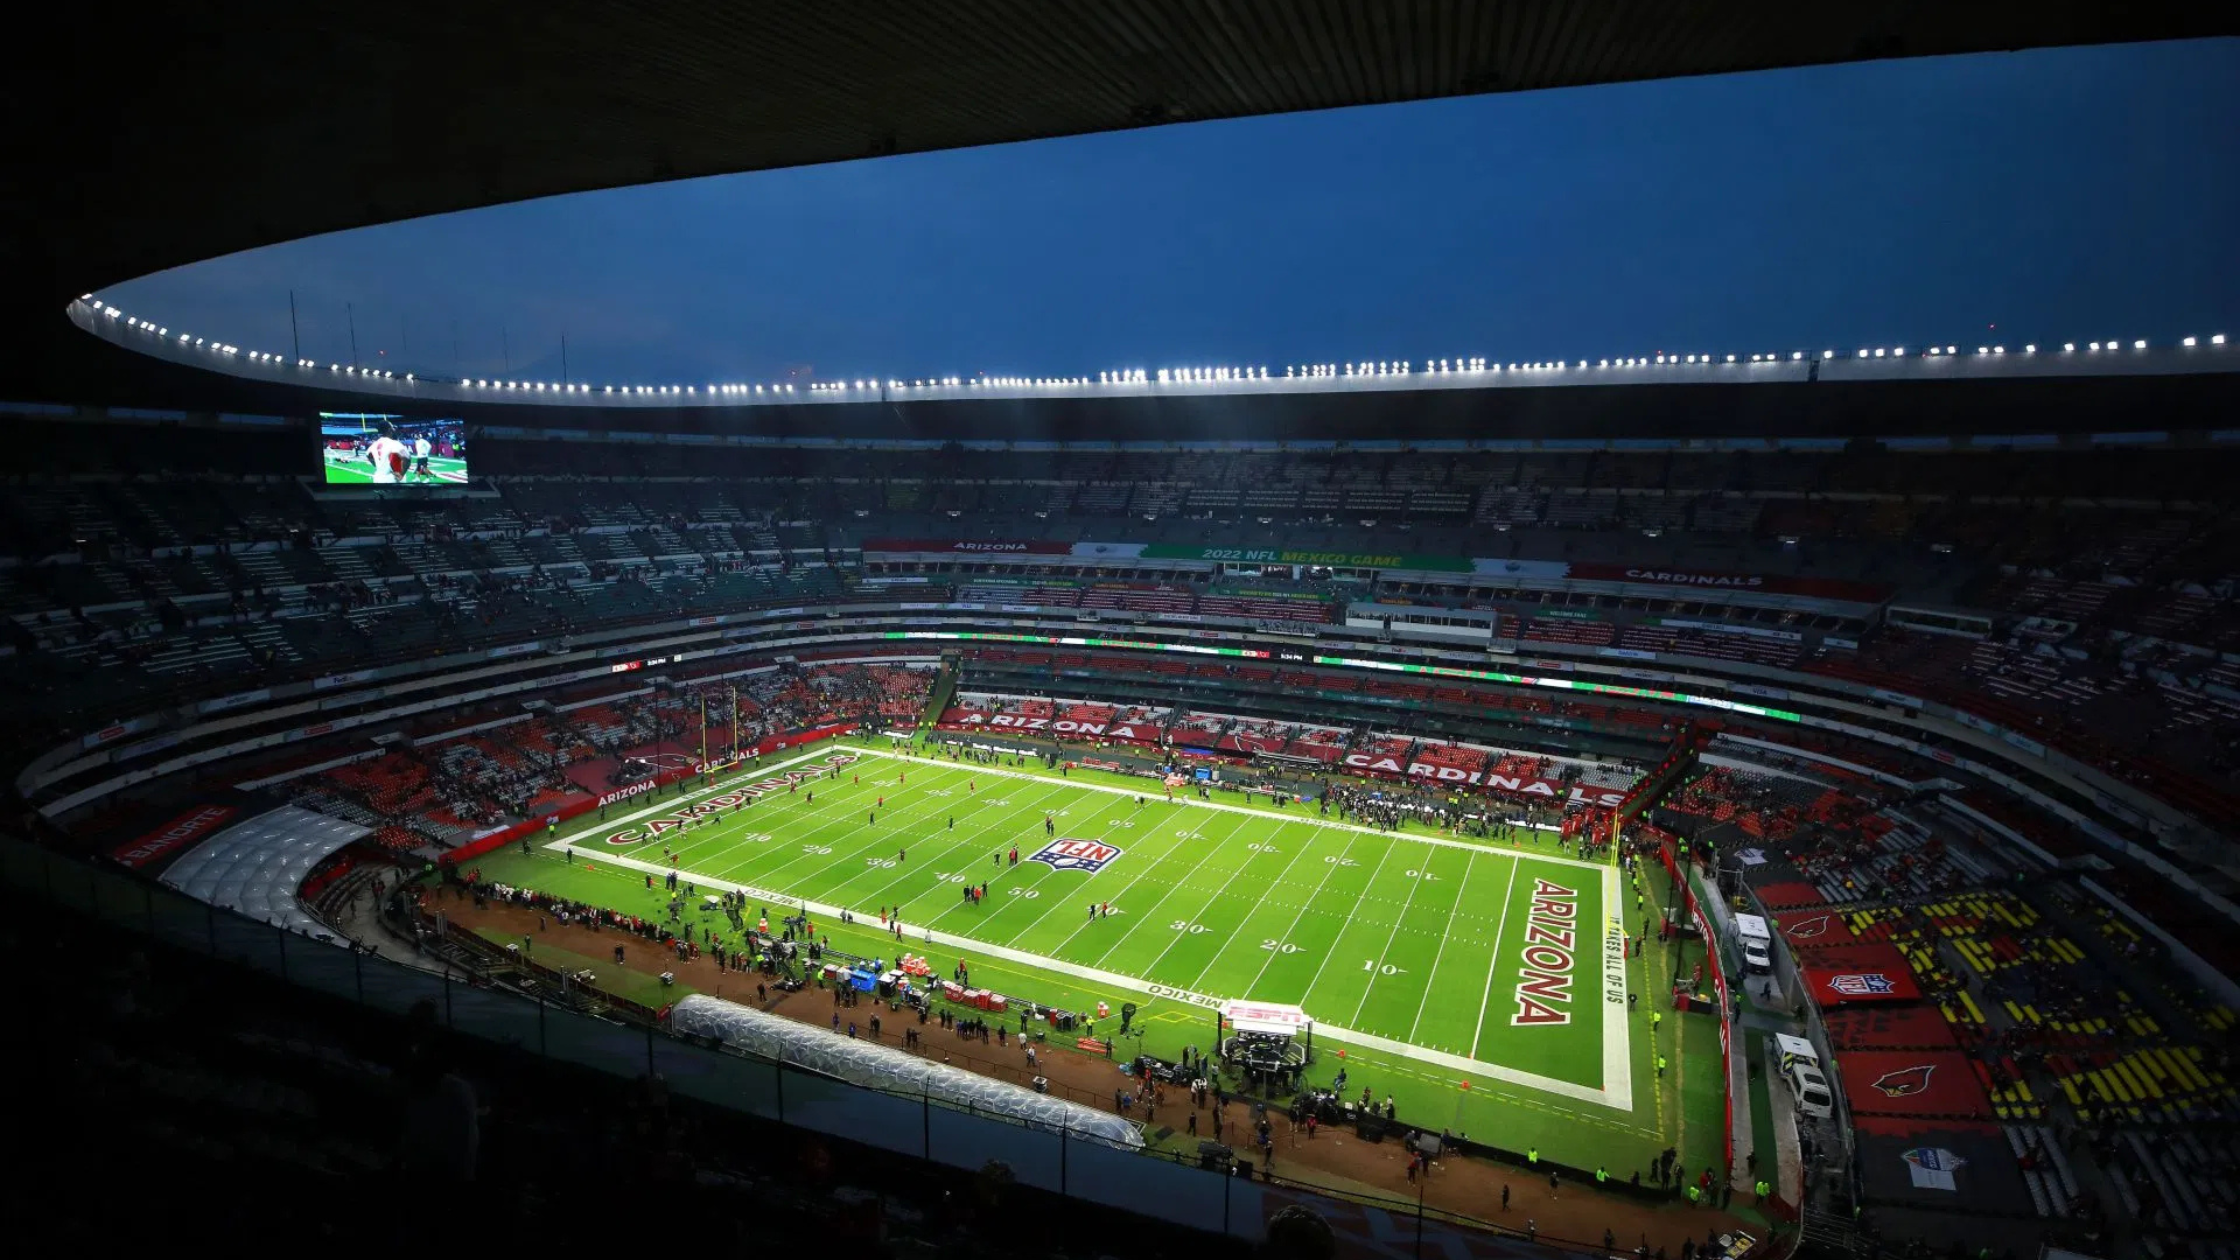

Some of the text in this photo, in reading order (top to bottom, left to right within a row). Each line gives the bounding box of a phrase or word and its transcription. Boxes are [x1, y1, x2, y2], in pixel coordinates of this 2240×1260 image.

[953, 541, 1028, 552] ARIZONA
[1201, 548, 1403, 567] 2022 NFL MEXICO GAME
[1625, 568, 1764, 587] CARDINALS
[959, 713, 1136, 738] ARIZONA
[1344, 753, 1626, 807] CARDINALS
[598, 779, 657, 807] ARIZONA
[606, 753, 858, 845] CARDINALS
[125, 808, 228, 859] BANORTE
[1058, 840, 1115, 862] NFL
[1405, 869, 1434, 880] 10
[1007, 887, 1040, 899] 50
[1169, 919, 1204, 934] 30
[1260, 938, 1298, 954] 20
[1510, 877, 1578, 1027] ARIZONA
[1361, 959, 1397, 976] 10
[1606, 953, 1624, 970] ALL
[1606, 974, 1623, 993] OF
[1149, 984, 1224, 1009] MEXICO
[1606, 993, 1624, 1005] US
[1228, 1006, 1302, 1023] ESPN
